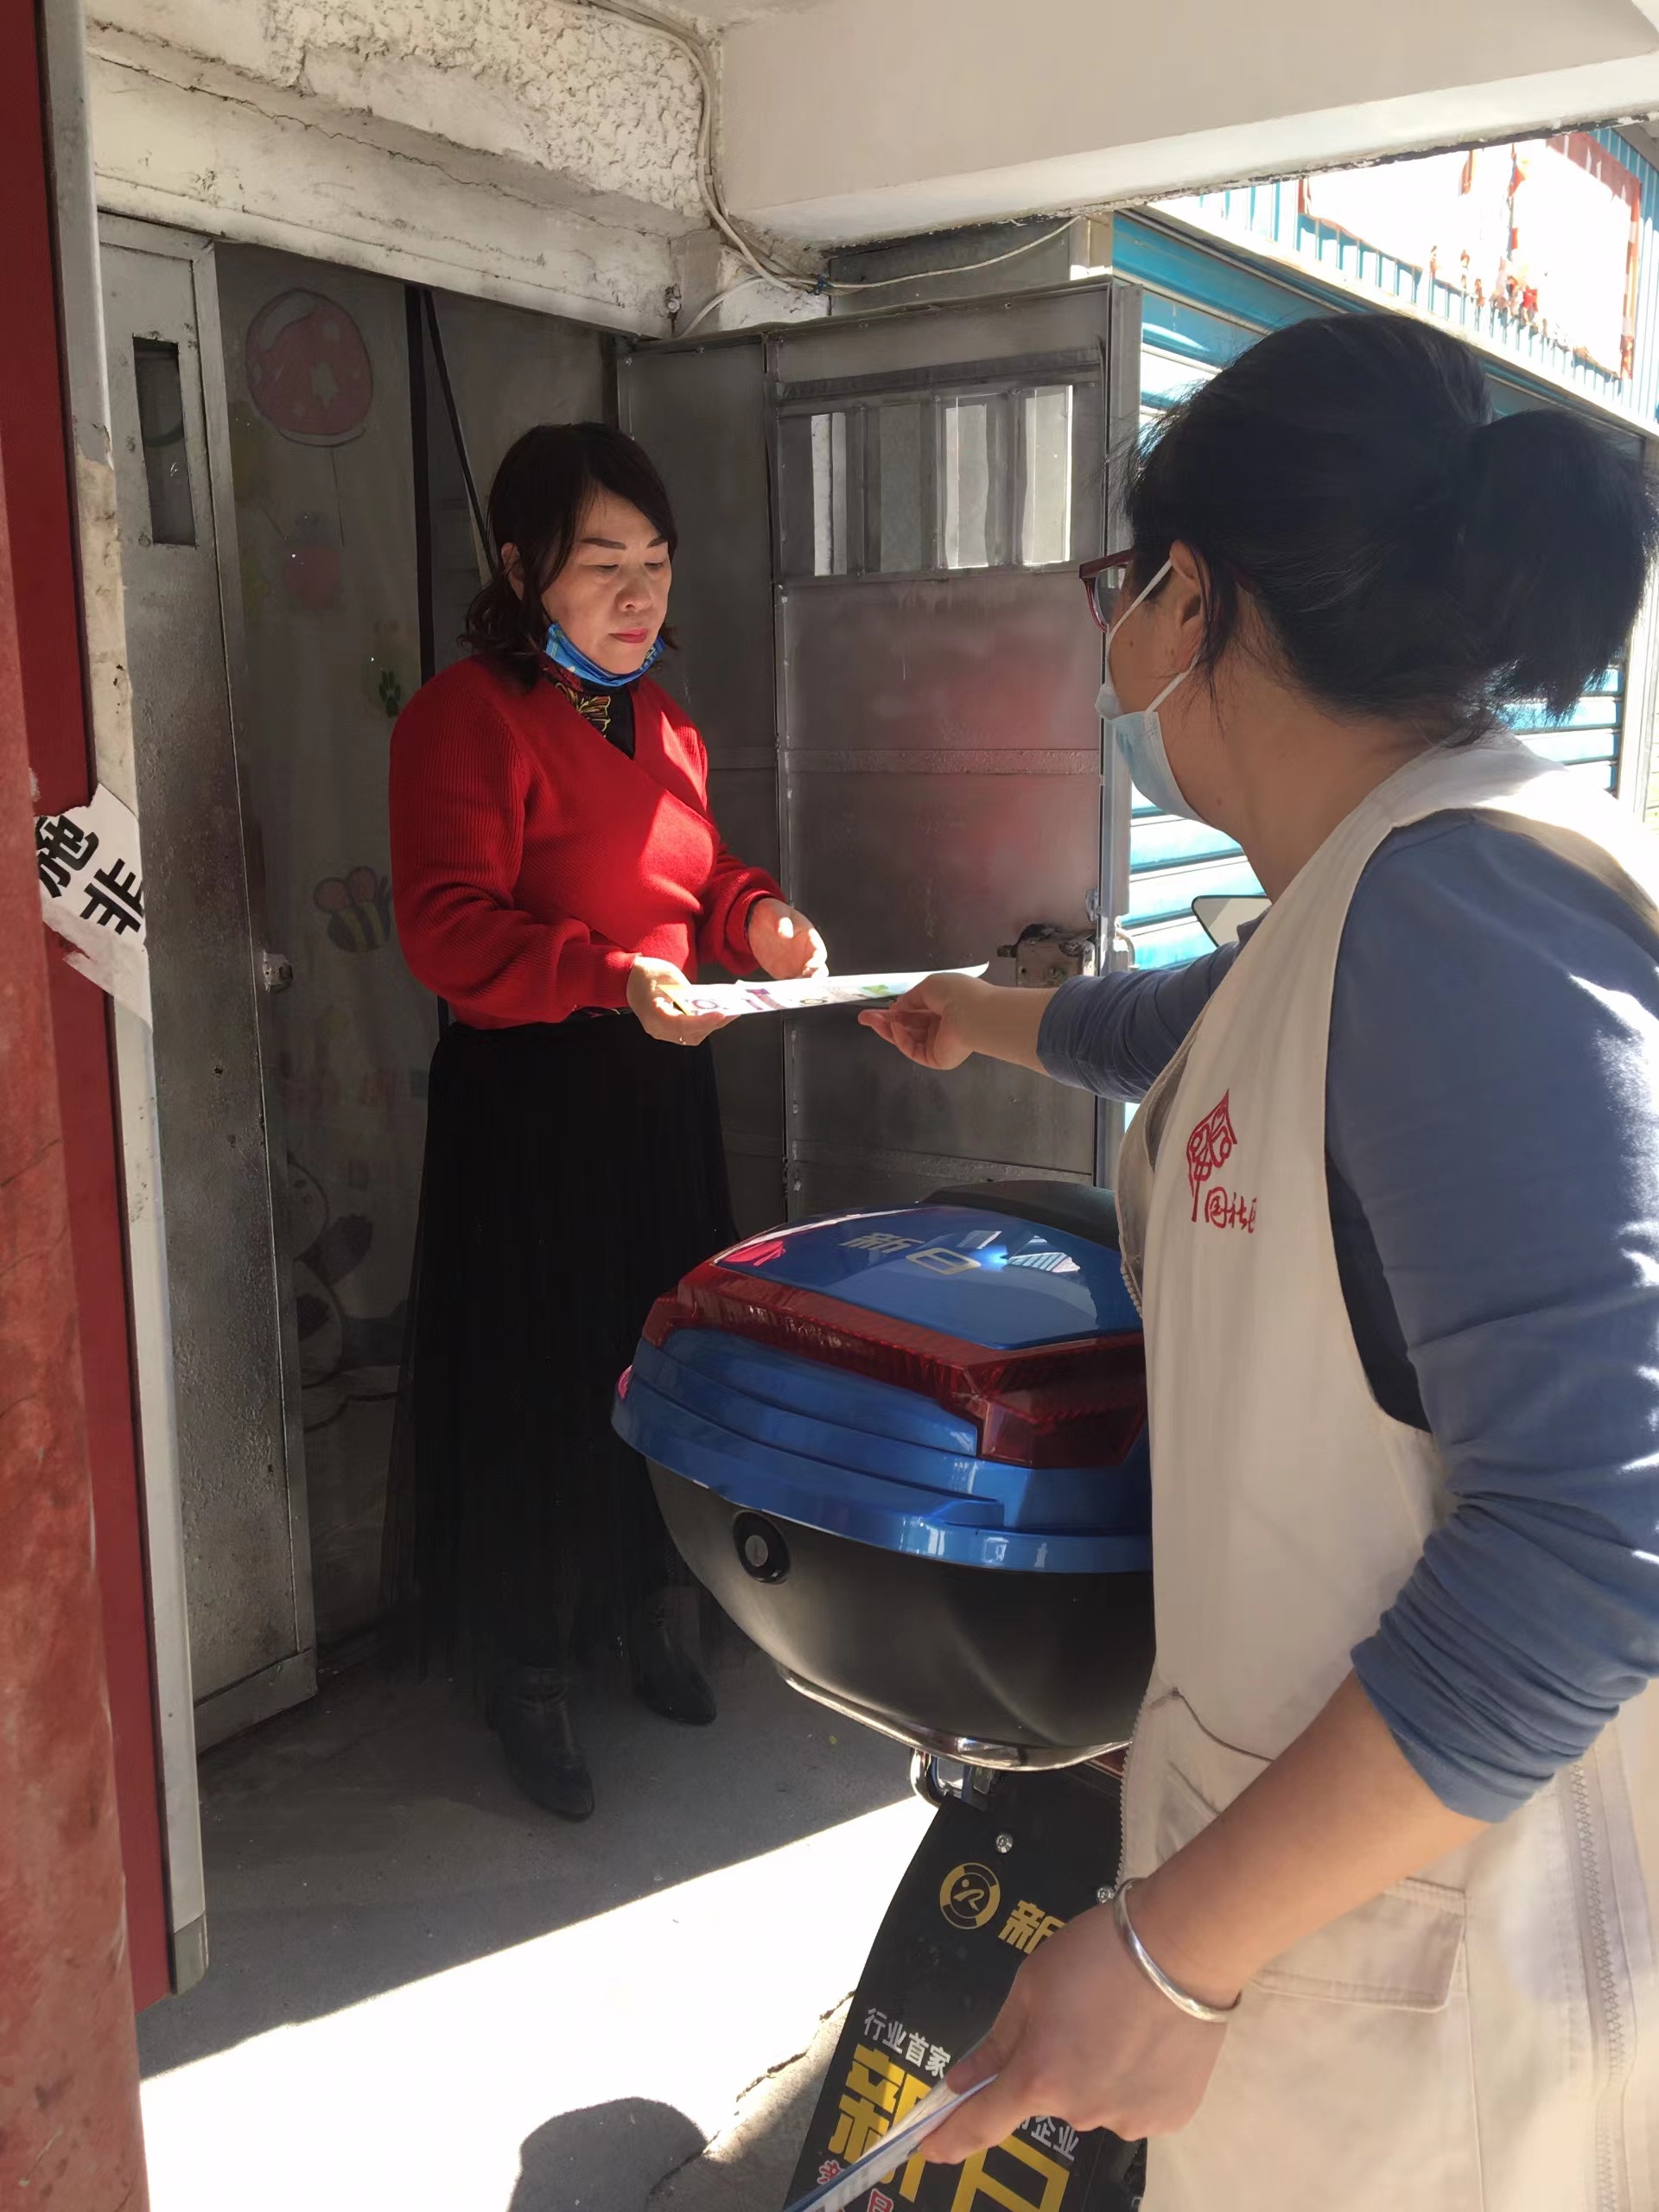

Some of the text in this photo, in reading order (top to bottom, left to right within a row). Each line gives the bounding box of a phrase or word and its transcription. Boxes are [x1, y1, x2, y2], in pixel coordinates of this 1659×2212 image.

[840, 1232, 982, 1275] 新日
[864, 2008, 951, 2079] 行业首家
